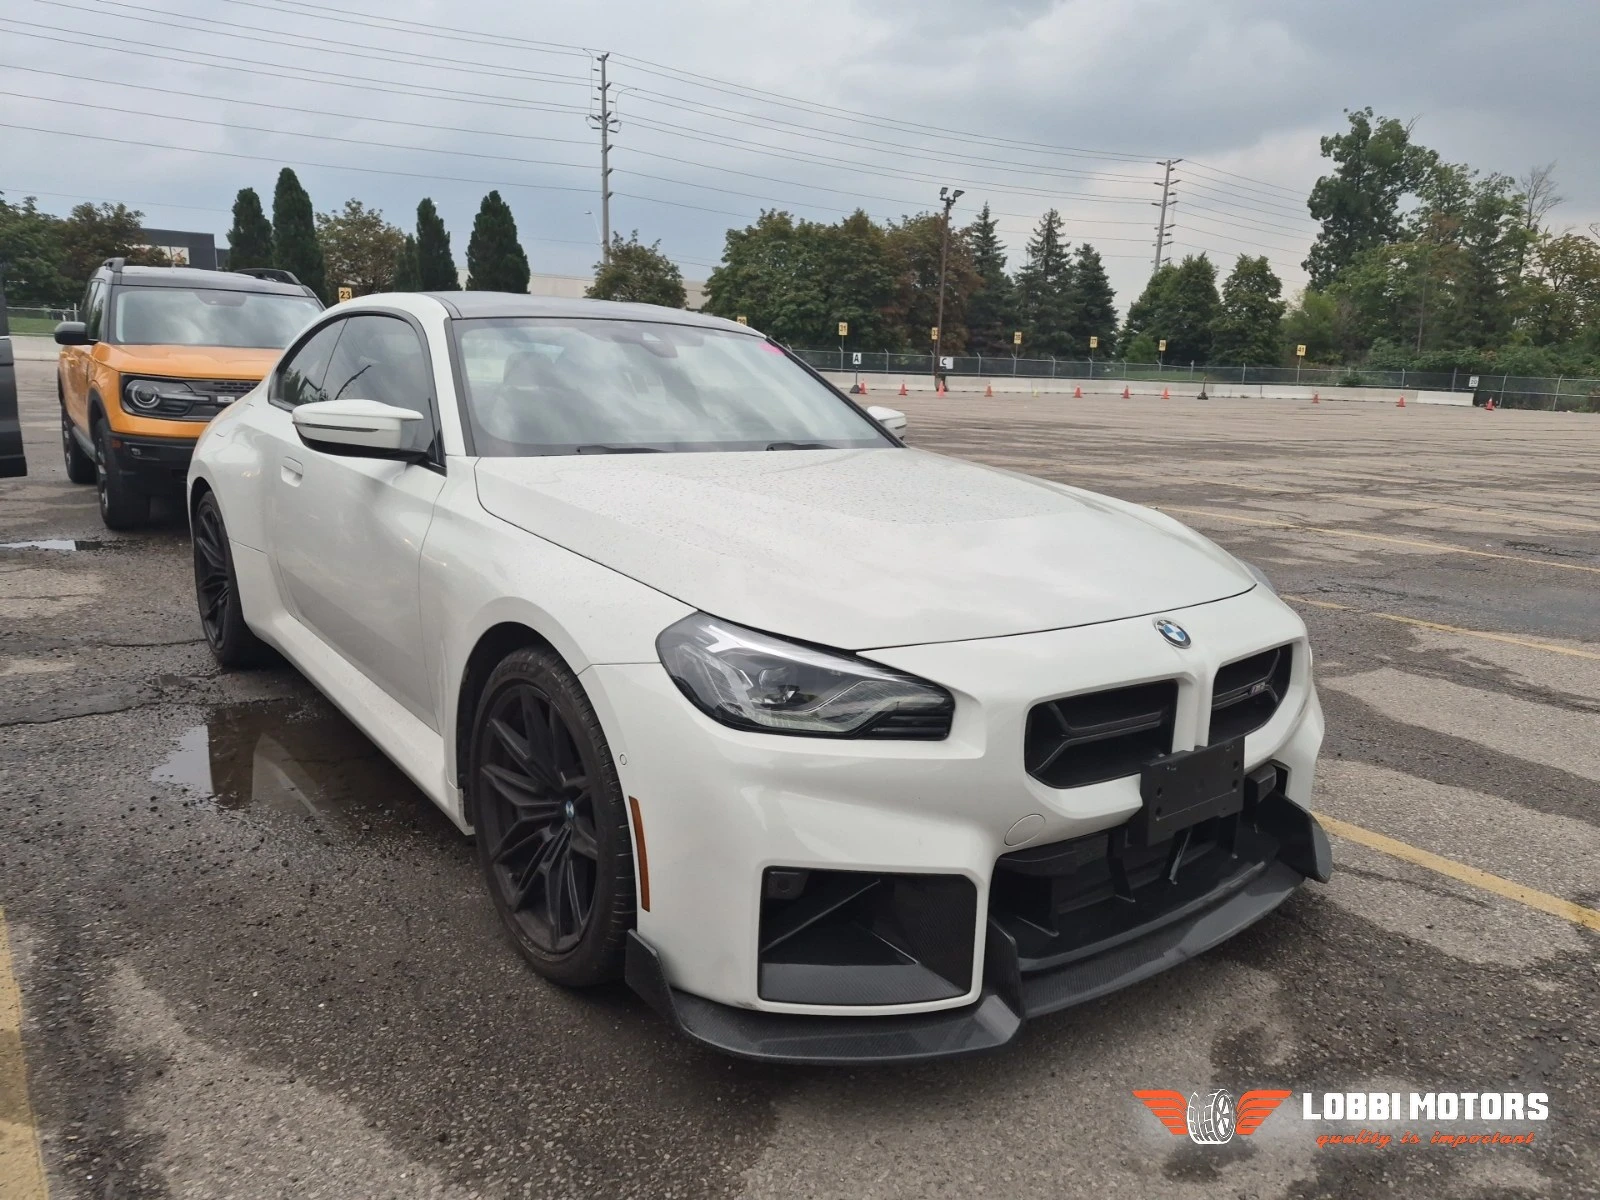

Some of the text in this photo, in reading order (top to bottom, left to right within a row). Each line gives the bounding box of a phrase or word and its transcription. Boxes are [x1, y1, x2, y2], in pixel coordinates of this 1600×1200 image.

[340, 290, 351, 300] 23
[839, 324, 847, 332] 31
[854, 353, 860, 363] A
[941, 357, 947, 365] C
